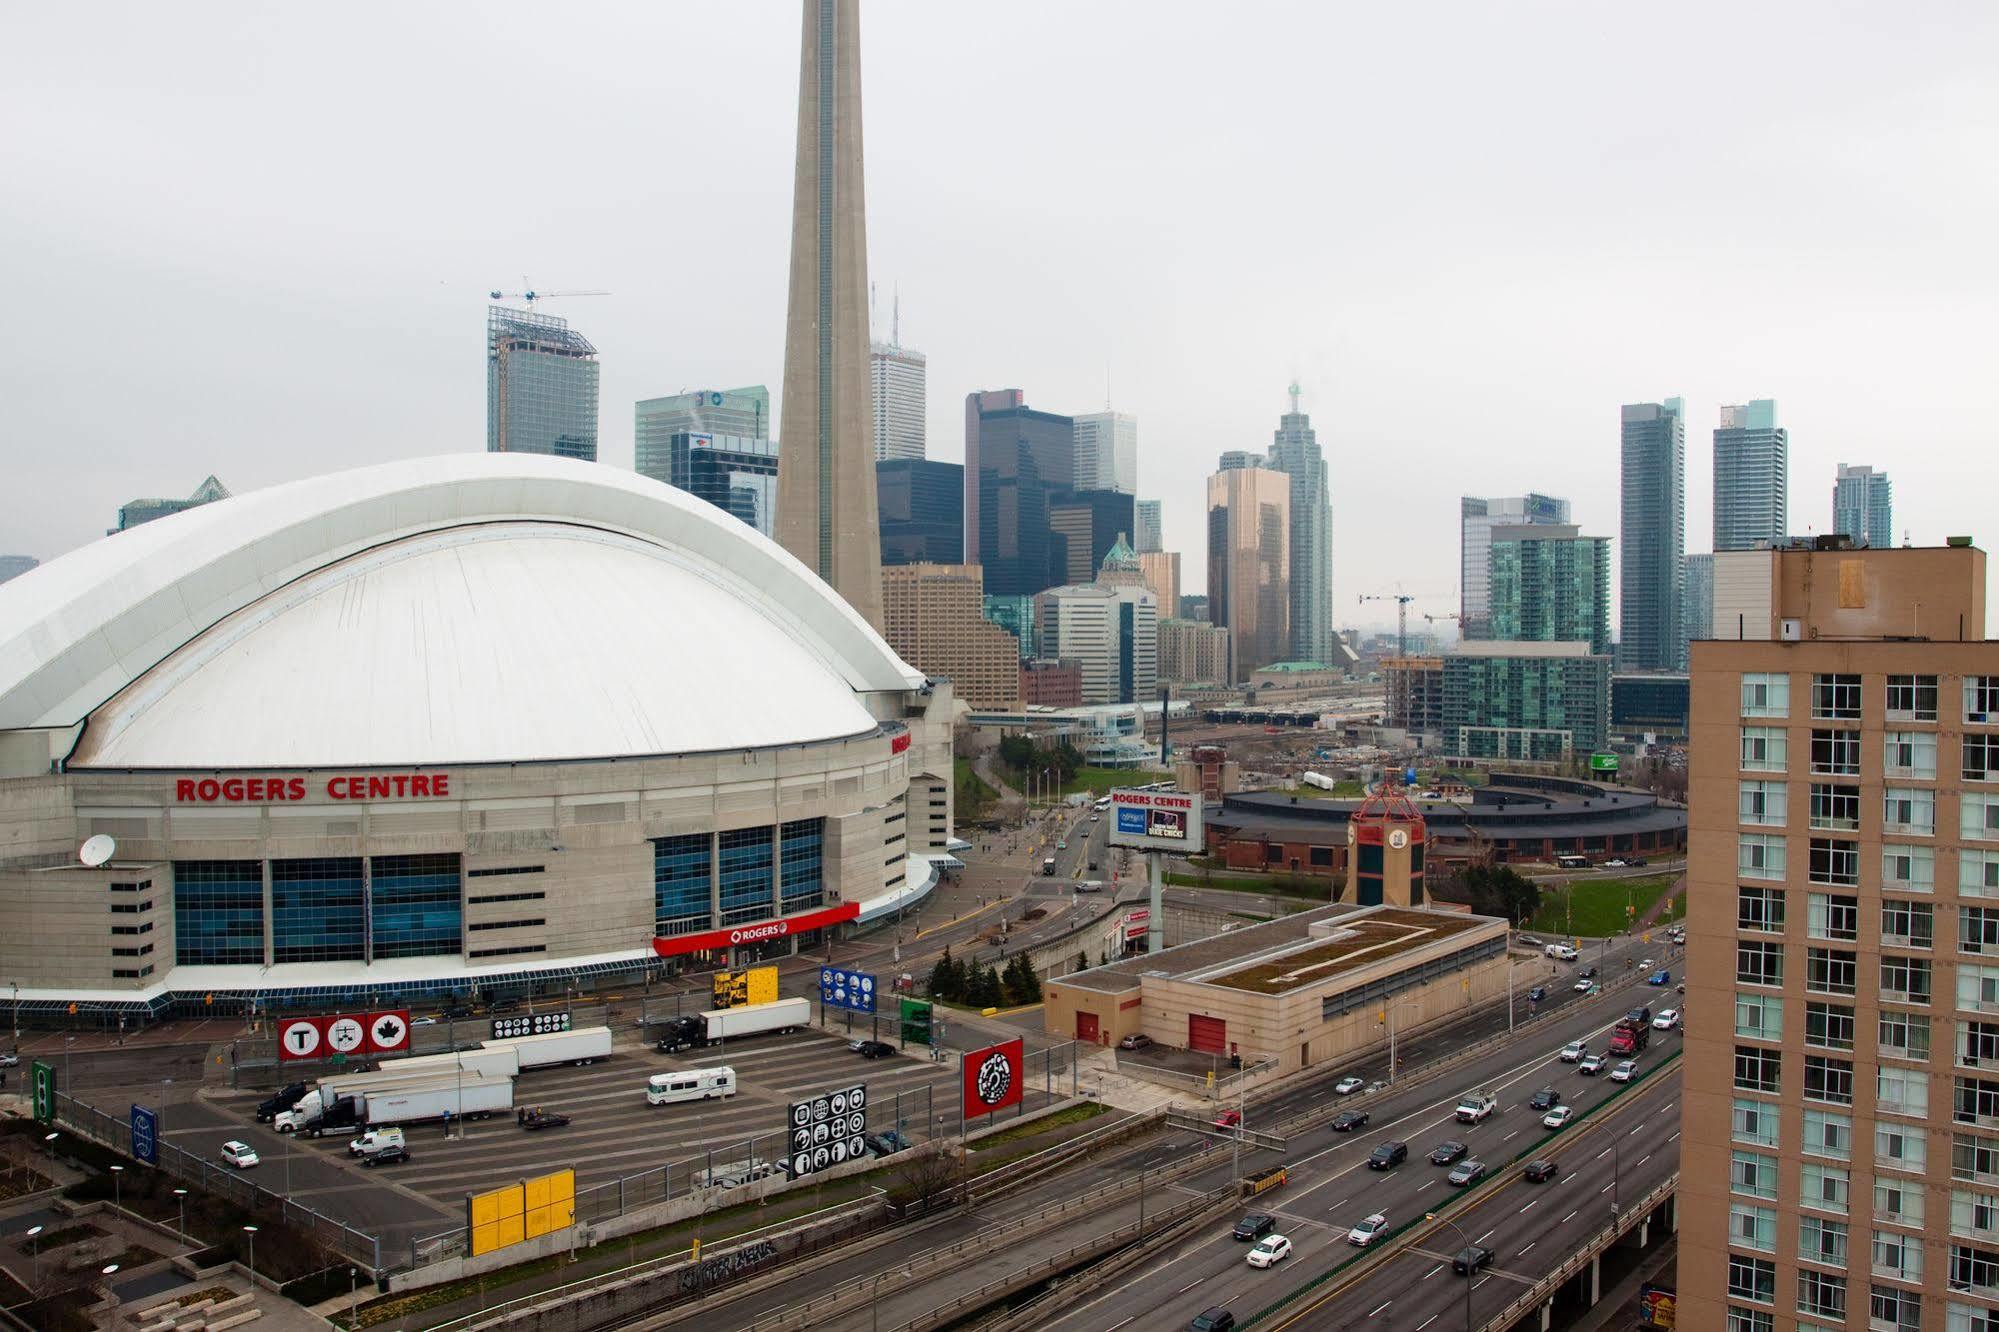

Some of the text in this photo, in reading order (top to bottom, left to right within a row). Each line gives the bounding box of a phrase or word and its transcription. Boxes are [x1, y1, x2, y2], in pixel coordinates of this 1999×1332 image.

[176, 775, 448, 801] ROGERS CENTRE
[1112, 793, 1192, 808] ROGERS CENTRE
[742, 925, 779, 940] ROGERS
